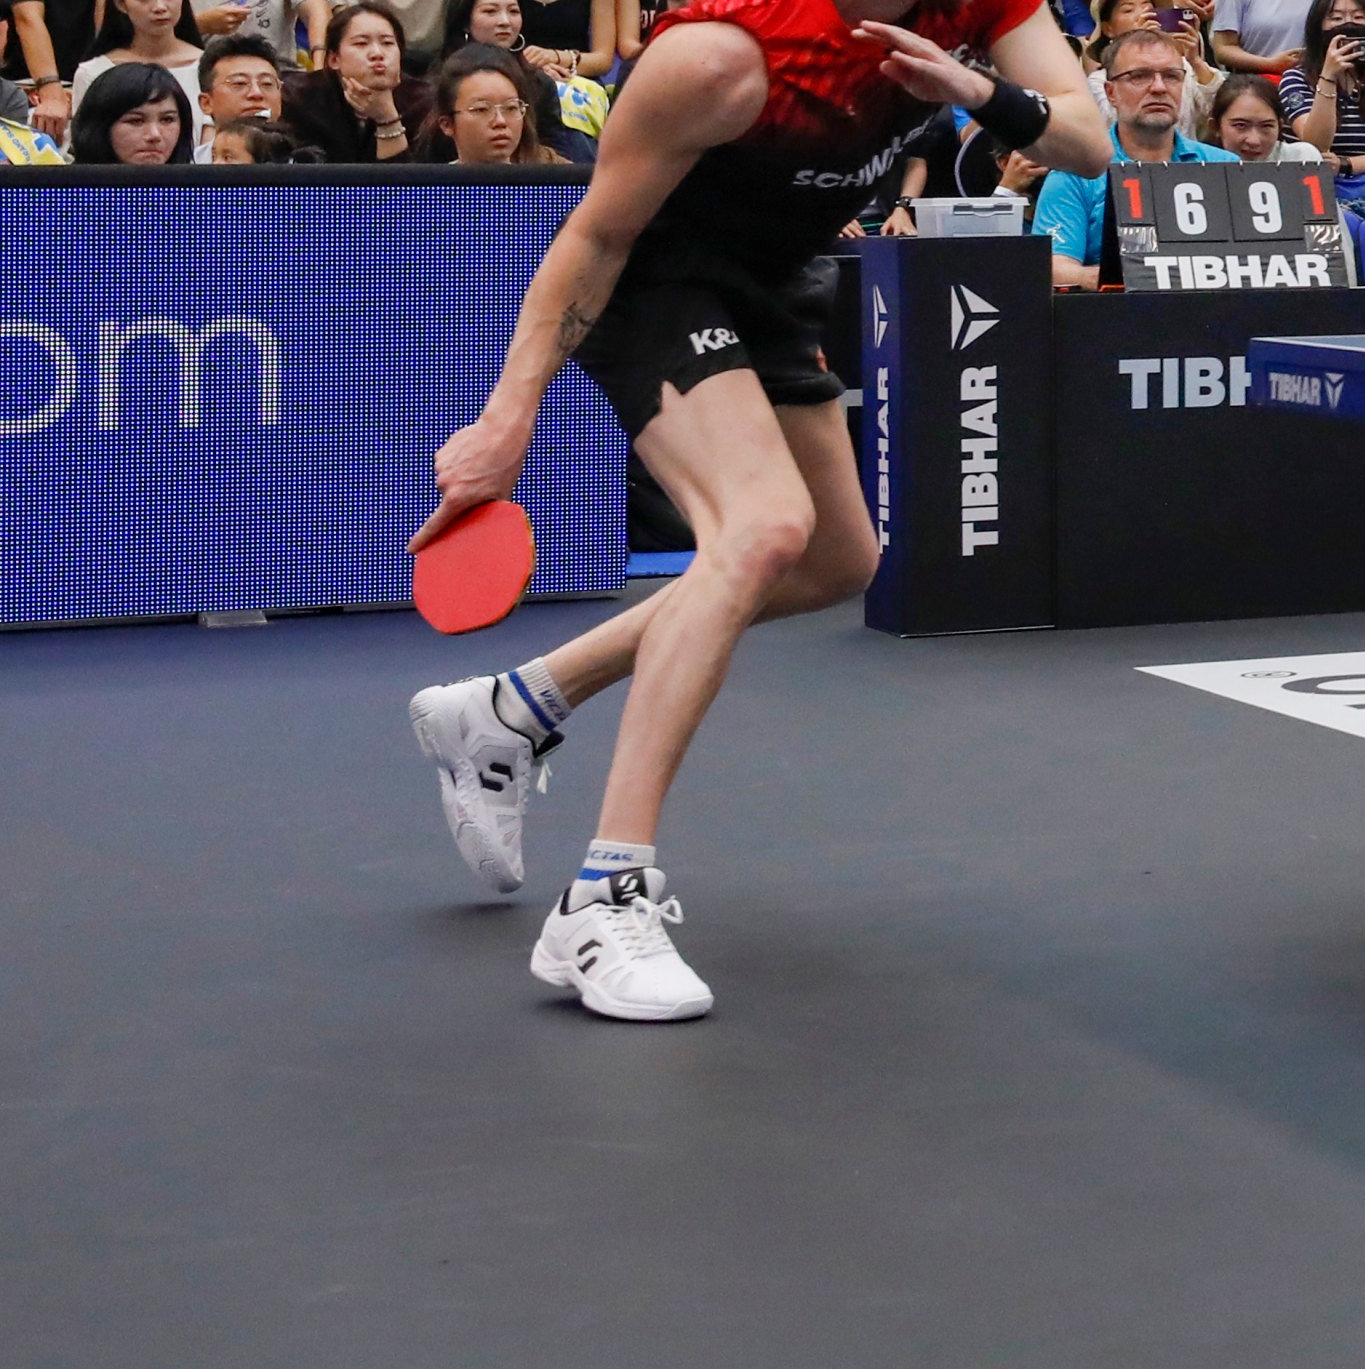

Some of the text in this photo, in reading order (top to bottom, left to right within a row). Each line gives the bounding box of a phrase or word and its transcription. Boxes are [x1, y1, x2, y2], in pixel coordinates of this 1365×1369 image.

[1122, 174, 1326, 236] 1 6 9 1
[1144, 253, 1333, 291] TIBHAR
[1268, 372, 1322, 407] TIBHAR
[960, 364, 999, 557] TIBHAR
